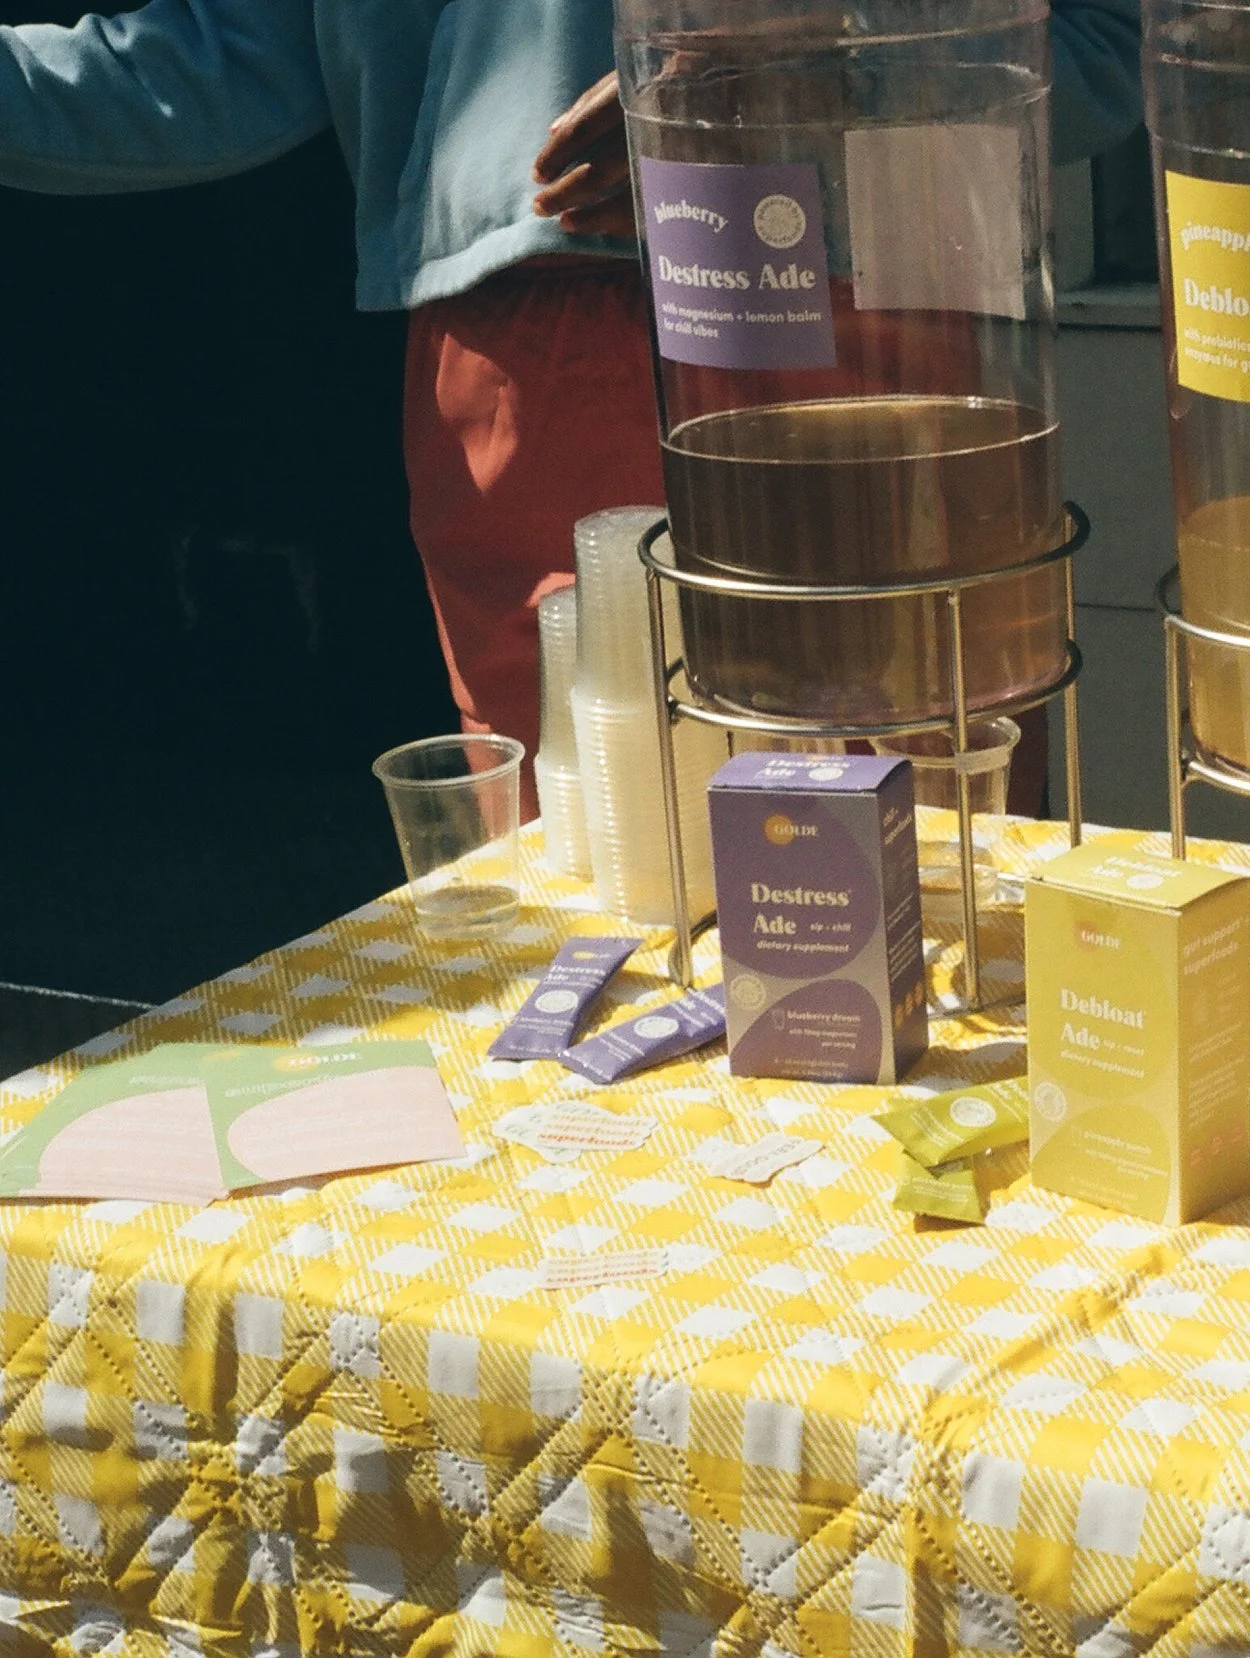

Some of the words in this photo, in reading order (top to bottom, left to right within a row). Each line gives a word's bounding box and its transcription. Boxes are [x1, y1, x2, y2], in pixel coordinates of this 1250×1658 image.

[654, 199, 728, 233] blueberry
[658, 255, 750, 290] Destress
[758, 263, 816, 290] Ade
[679, 306, 733, 322] magnesium
[745, 311, 784, 322] lemon
[787, 310, 822, 322] balm
[693, 325, 718, 337] vibes
[1223, 354, 1238, 368] for
[751, 882, 850, 907] Destress
[753, 912, 797, 935] Ade
[757, 940, 791, 952] dietary
[793, 943, 849, 953] supplement
[1061, 988, 1143, 1030] Debloat
[1061, 1021, 1100, 1050] Ade
